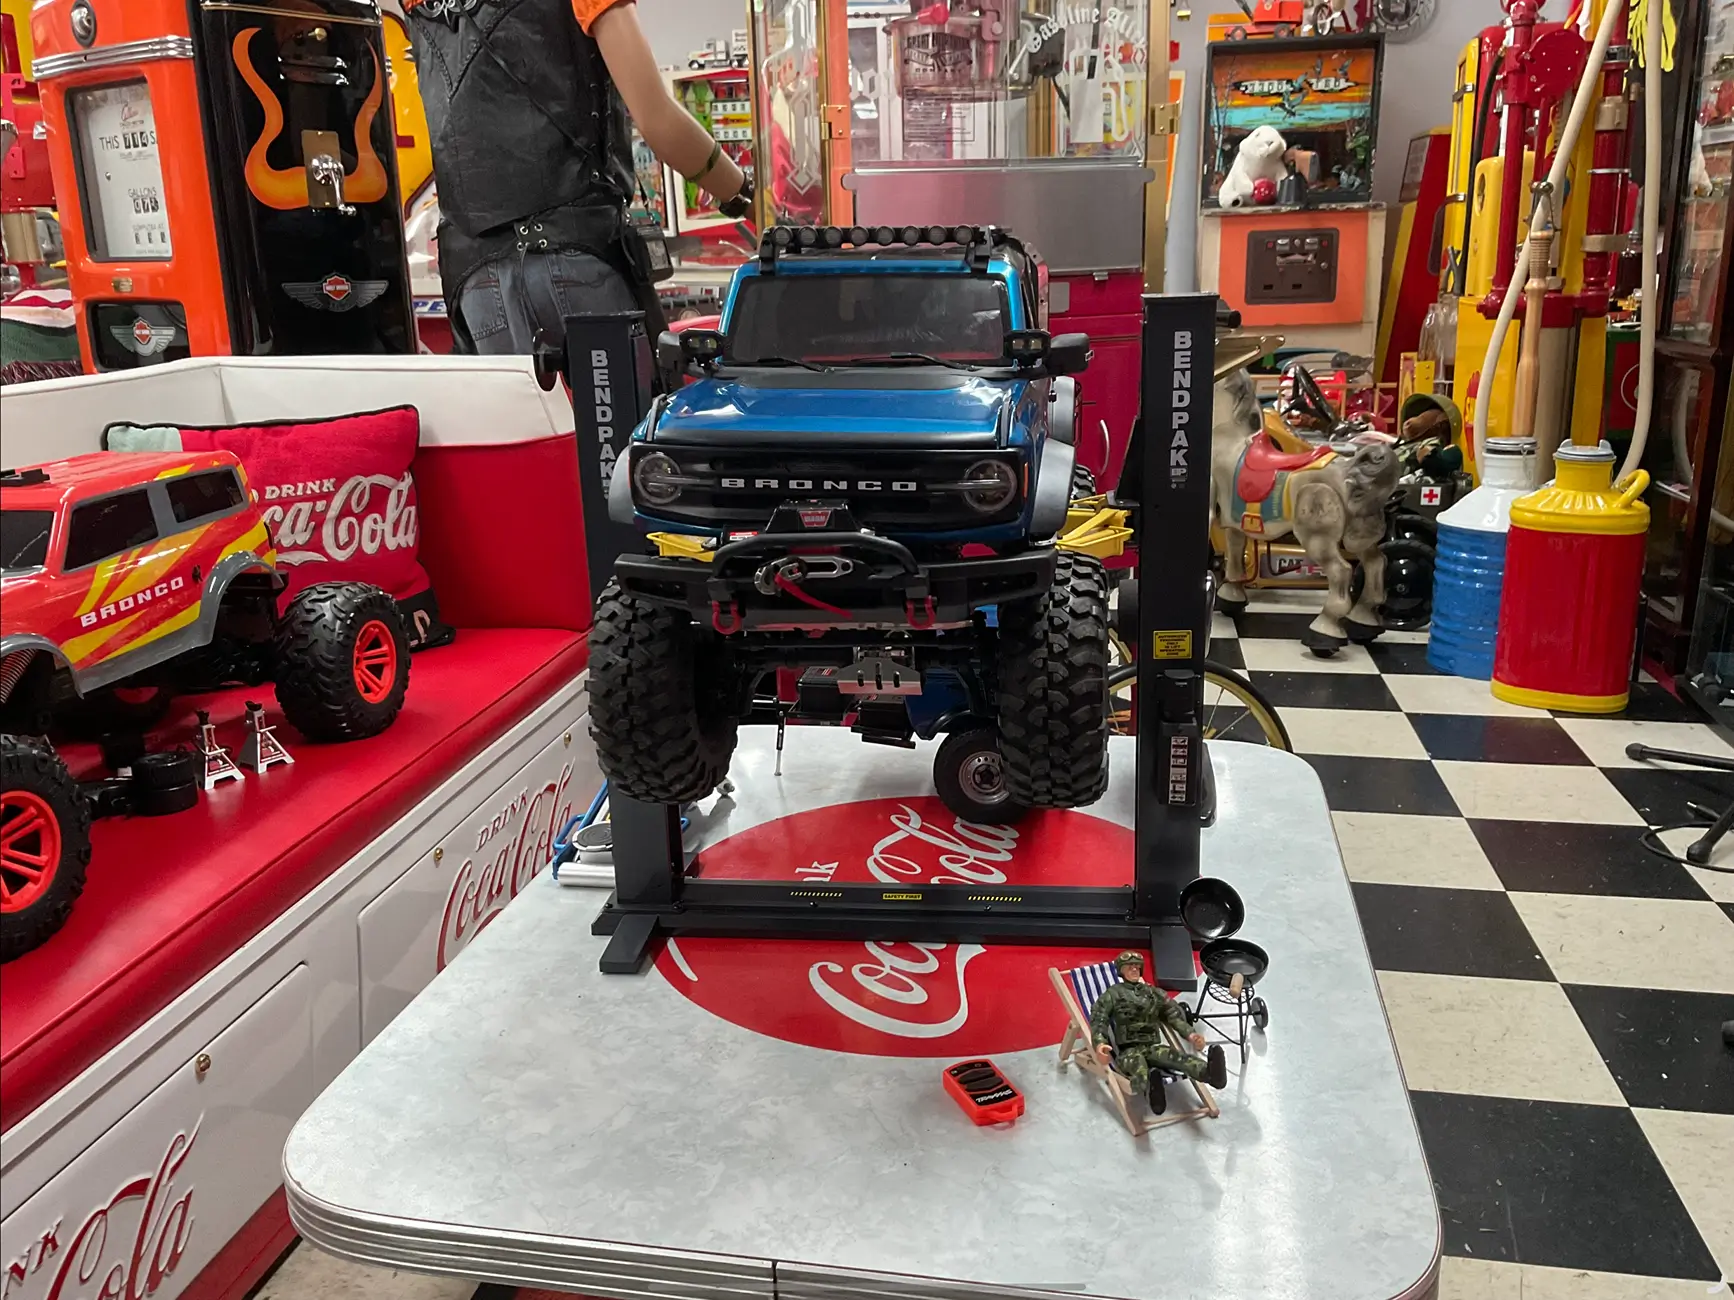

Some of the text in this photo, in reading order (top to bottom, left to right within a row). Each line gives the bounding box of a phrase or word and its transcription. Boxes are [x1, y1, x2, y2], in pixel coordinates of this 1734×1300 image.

[99, 135, 120, 150] THIS
[128, 187, 157, 198] GALLONS
[590, 350, 616, 478] BENDPAK
[1170, 331, 1192, 466] BENDPAK
[265, 478, 336, 500] DRINK
[721, 478, 917, 491] BRONCO
[81, 576, 184, 628] BRONCO
[476, 787, 528, 852] DRINK
